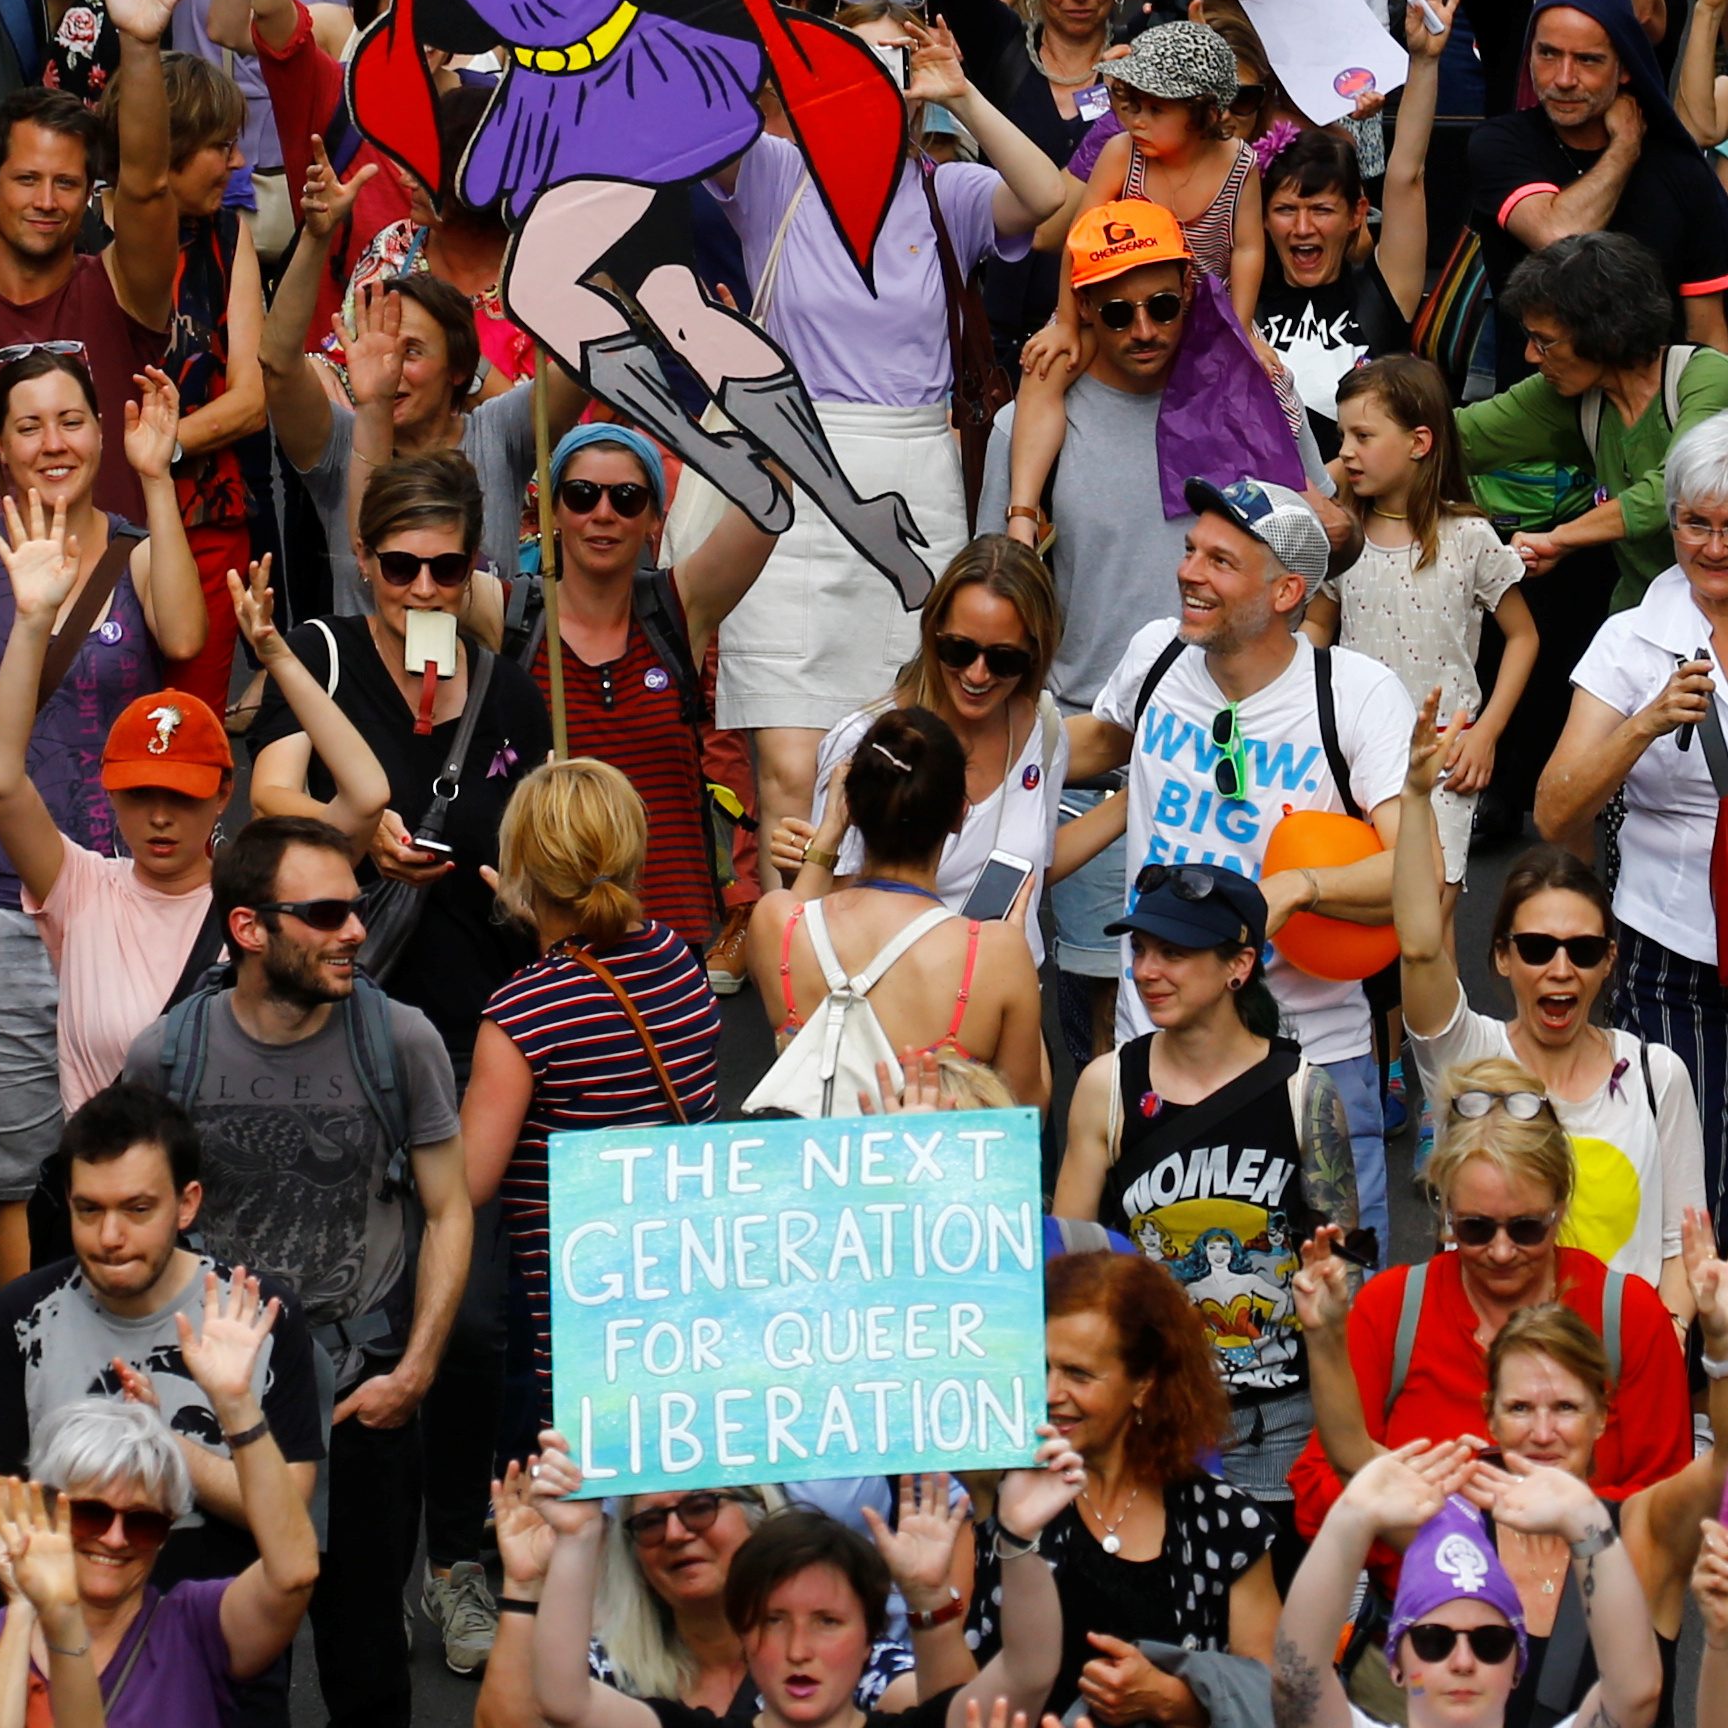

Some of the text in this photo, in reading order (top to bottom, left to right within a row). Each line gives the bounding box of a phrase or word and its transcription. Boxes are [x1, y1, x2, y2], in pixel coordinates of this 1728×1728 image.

[1088, 237, 1159, 262] CHEMSEARCH
[81, 749, 113, 855] REALLY
[1154, 778, 1262, 845] BIG
[598, 1130, 1007, 1205] THE NEXT
[1122, 1144, 1295, 1216] WOMEN
[561, 1200, 1036, 1307] GENERATION
[604, 1301, 988, 1384] FOR QUEER
[578, 1375, 1026, 1481] LIBERATION
